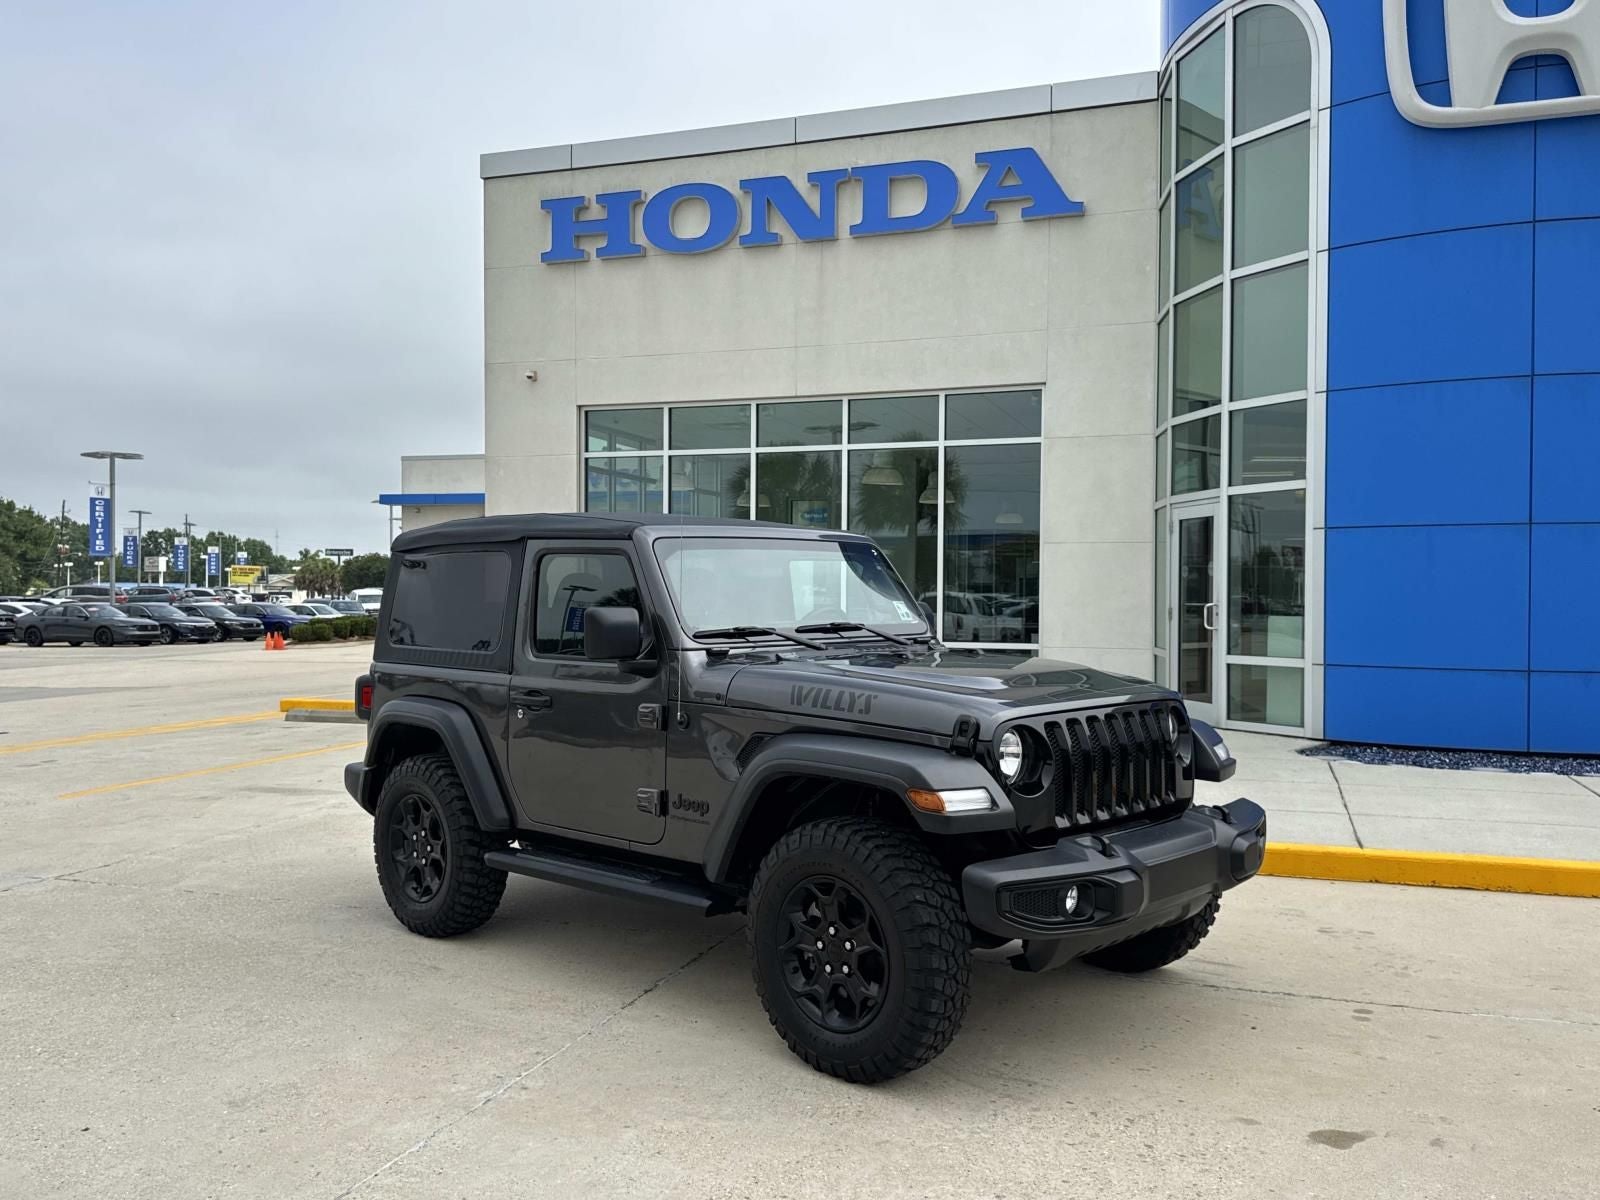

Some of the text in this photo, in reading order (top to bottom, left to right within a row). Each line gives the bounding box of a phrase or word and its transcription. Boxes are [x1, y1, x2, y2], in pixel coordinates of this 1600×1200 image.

[541, 147, 1085, 264] HONDA
[95, 500, 105, 551] CERTIFIED
[790, 684, 878, 715] WILLYS
[672, 793, 710, 817] Jeep
